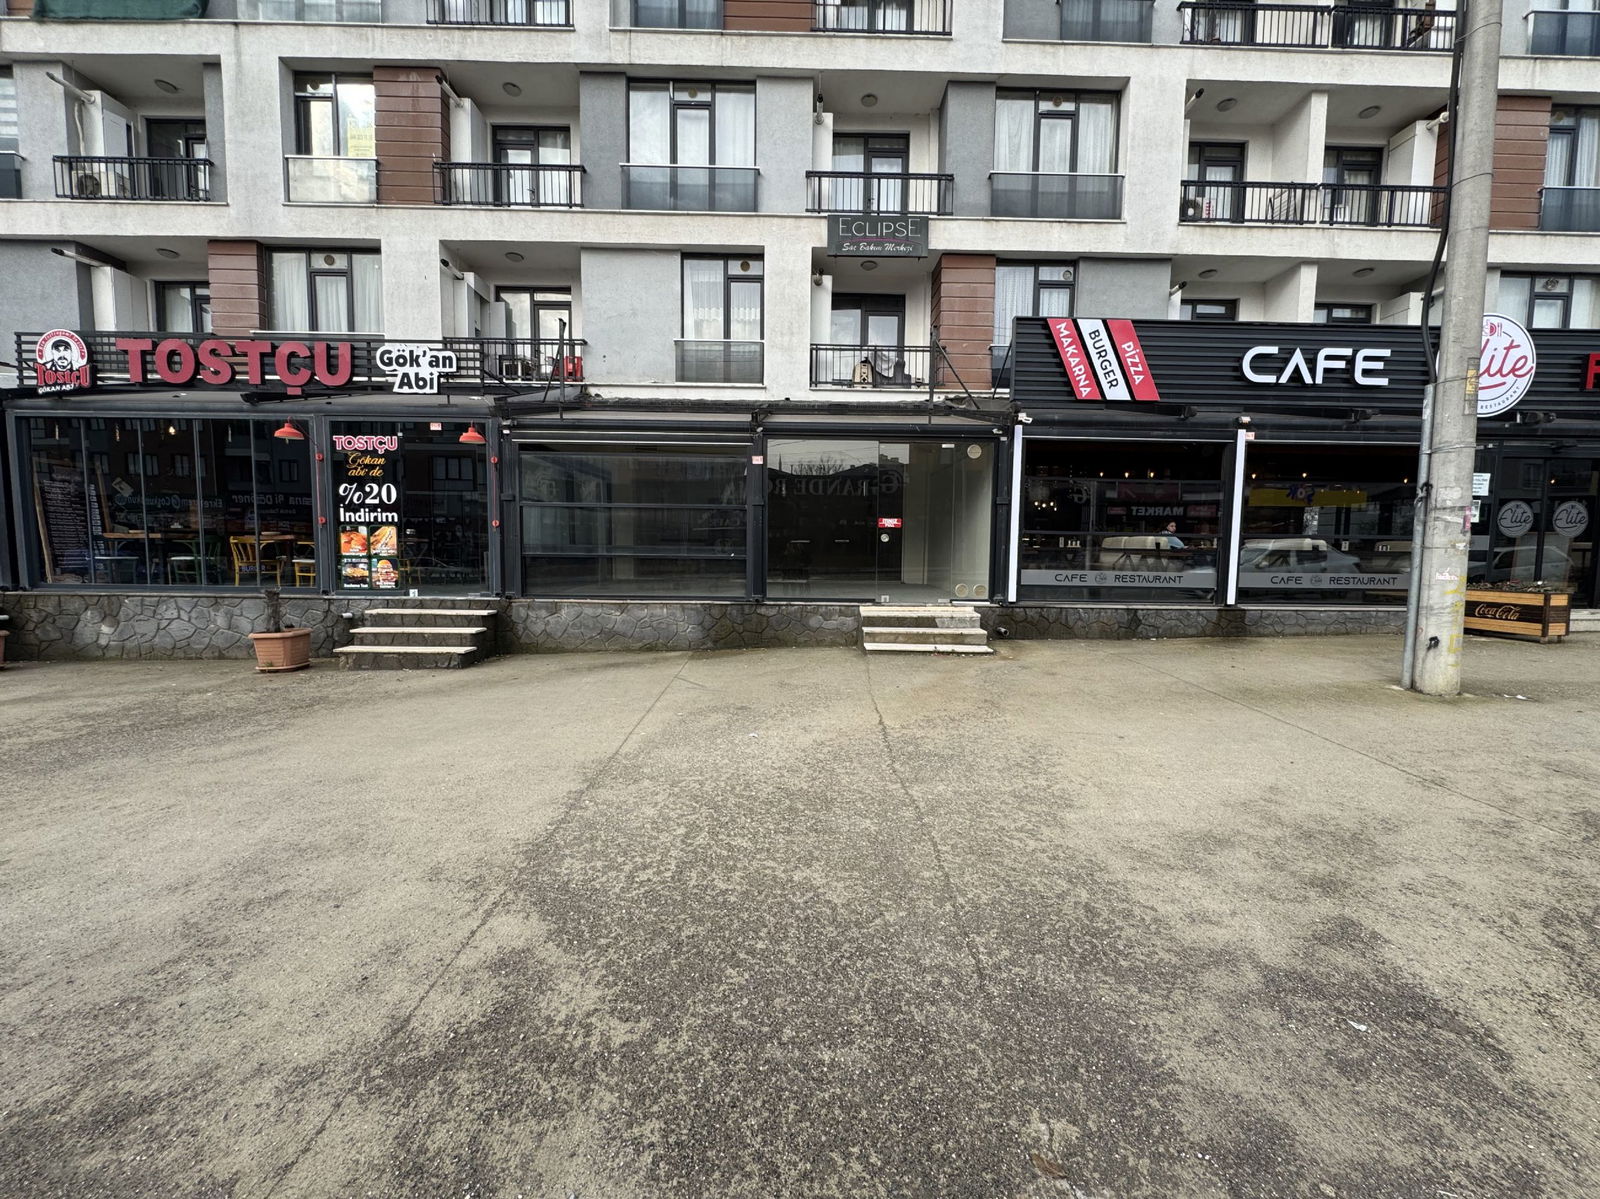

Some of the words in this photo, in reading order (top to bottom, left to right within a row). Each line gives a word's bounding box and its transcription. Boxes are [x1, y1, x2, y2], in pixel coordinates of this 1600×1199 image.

[839, 218, 921, 237] ECLIPSE
[115, 338, 353, 396] TOSTÇU
[1056, 322, 1092, 398] MAKARNA
[1088, 329, 1119, 390] BURGER
[1242, 346, 1392, 386] CAFE
[397, 371, 437, 390] Abi
[333, 435, 398, 454] TOSTÇU
[338, 482, 398, 505] %20
[339, 503, 399, 522] İndirim
[1499, 507, 1531, 529] Elite
[1553, 508, 1586, 529] Elite
[1054, 573, 1087, 582] CAFE
[1114, 574, 1184, 584] RESTAURANT
[1270, 575, 1303, 585] CAFE
[1329, 576, 1398, 586] RESTAURANT
